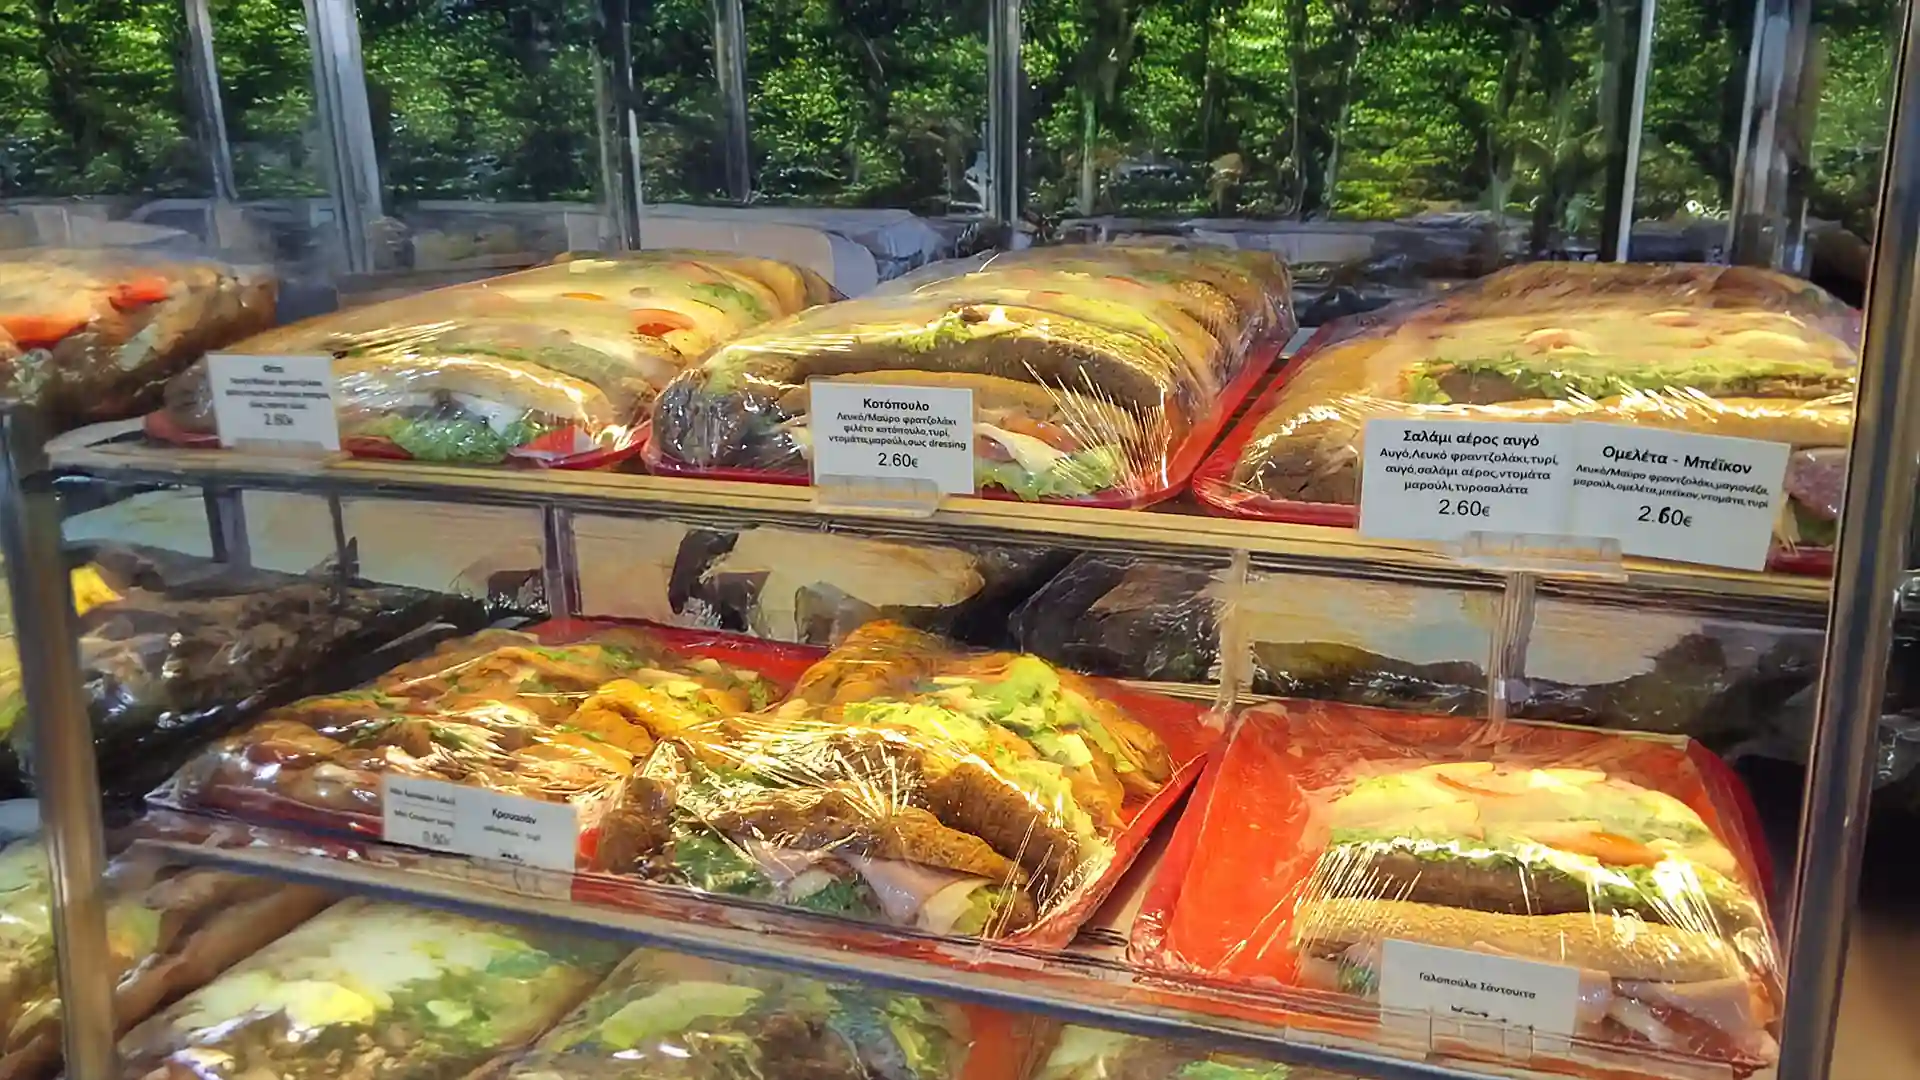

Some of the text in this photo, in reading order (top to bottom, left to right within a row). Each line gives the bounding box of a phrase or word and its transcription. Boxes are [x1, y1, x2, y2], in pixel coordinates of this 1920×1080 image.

[863, 398, 930, 411] Κοτόπουλο
[837, 412, 900, 424] Λευκό/Μαύρο
[843, 424, 874, 434] φιλέτο
[929, 439, 967, 451] dressing
[1403, 430, 1540, 449] Σαλάμι αέρος αυγό
[878, 452, 919, 468] 2.60€
[1380, 447, 1447, 461] Αυγό,Λευκό
[1602, 445, 1668, 465] Ομελέτα
[1684, 454, 1753, 475] Μπέϊκον
[1385, 464, 1458, 477] αυγό,σαλάμι
[1576, 464, 1646, 480] Λευκό/Μαύρο
[1404, 481, 1529, 495] μαρούλι,τυροσαλάτα
[1438, 499, 1490, 517] 2.60€
[1637, 505, 1693, 528] 2.60€
[1419, 972, 1477, 990] Γαλοπούλα
